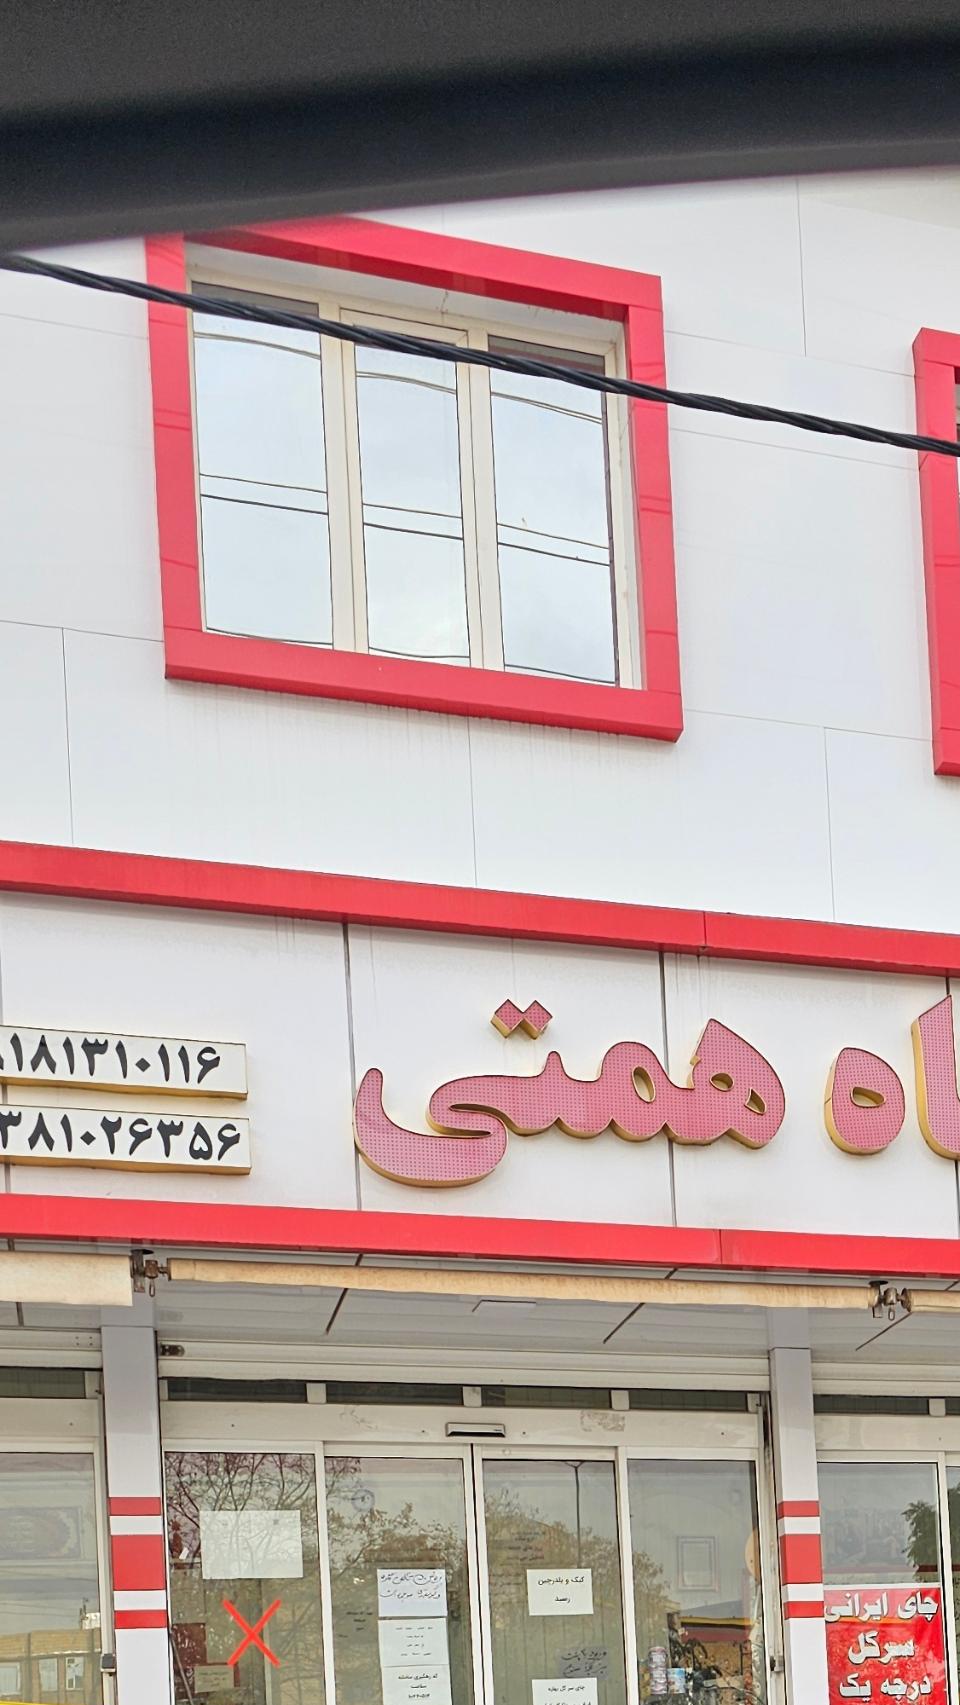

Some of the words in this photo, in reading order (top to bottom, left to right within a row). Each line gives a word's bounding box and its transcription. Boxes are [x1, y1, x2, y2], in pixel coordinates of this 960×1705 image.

[0, 1033, 220, 1084] ۱۸۱۳۱۰۱۱۶
[353, 998, 786, 1188] همتی
[824, 1591, 888, 1622] ایرانی
[897, 1591, 939, 1621] چای
[839, 1672, 872, 1702] یک
[880, 1675, 933, 1700] درجه
